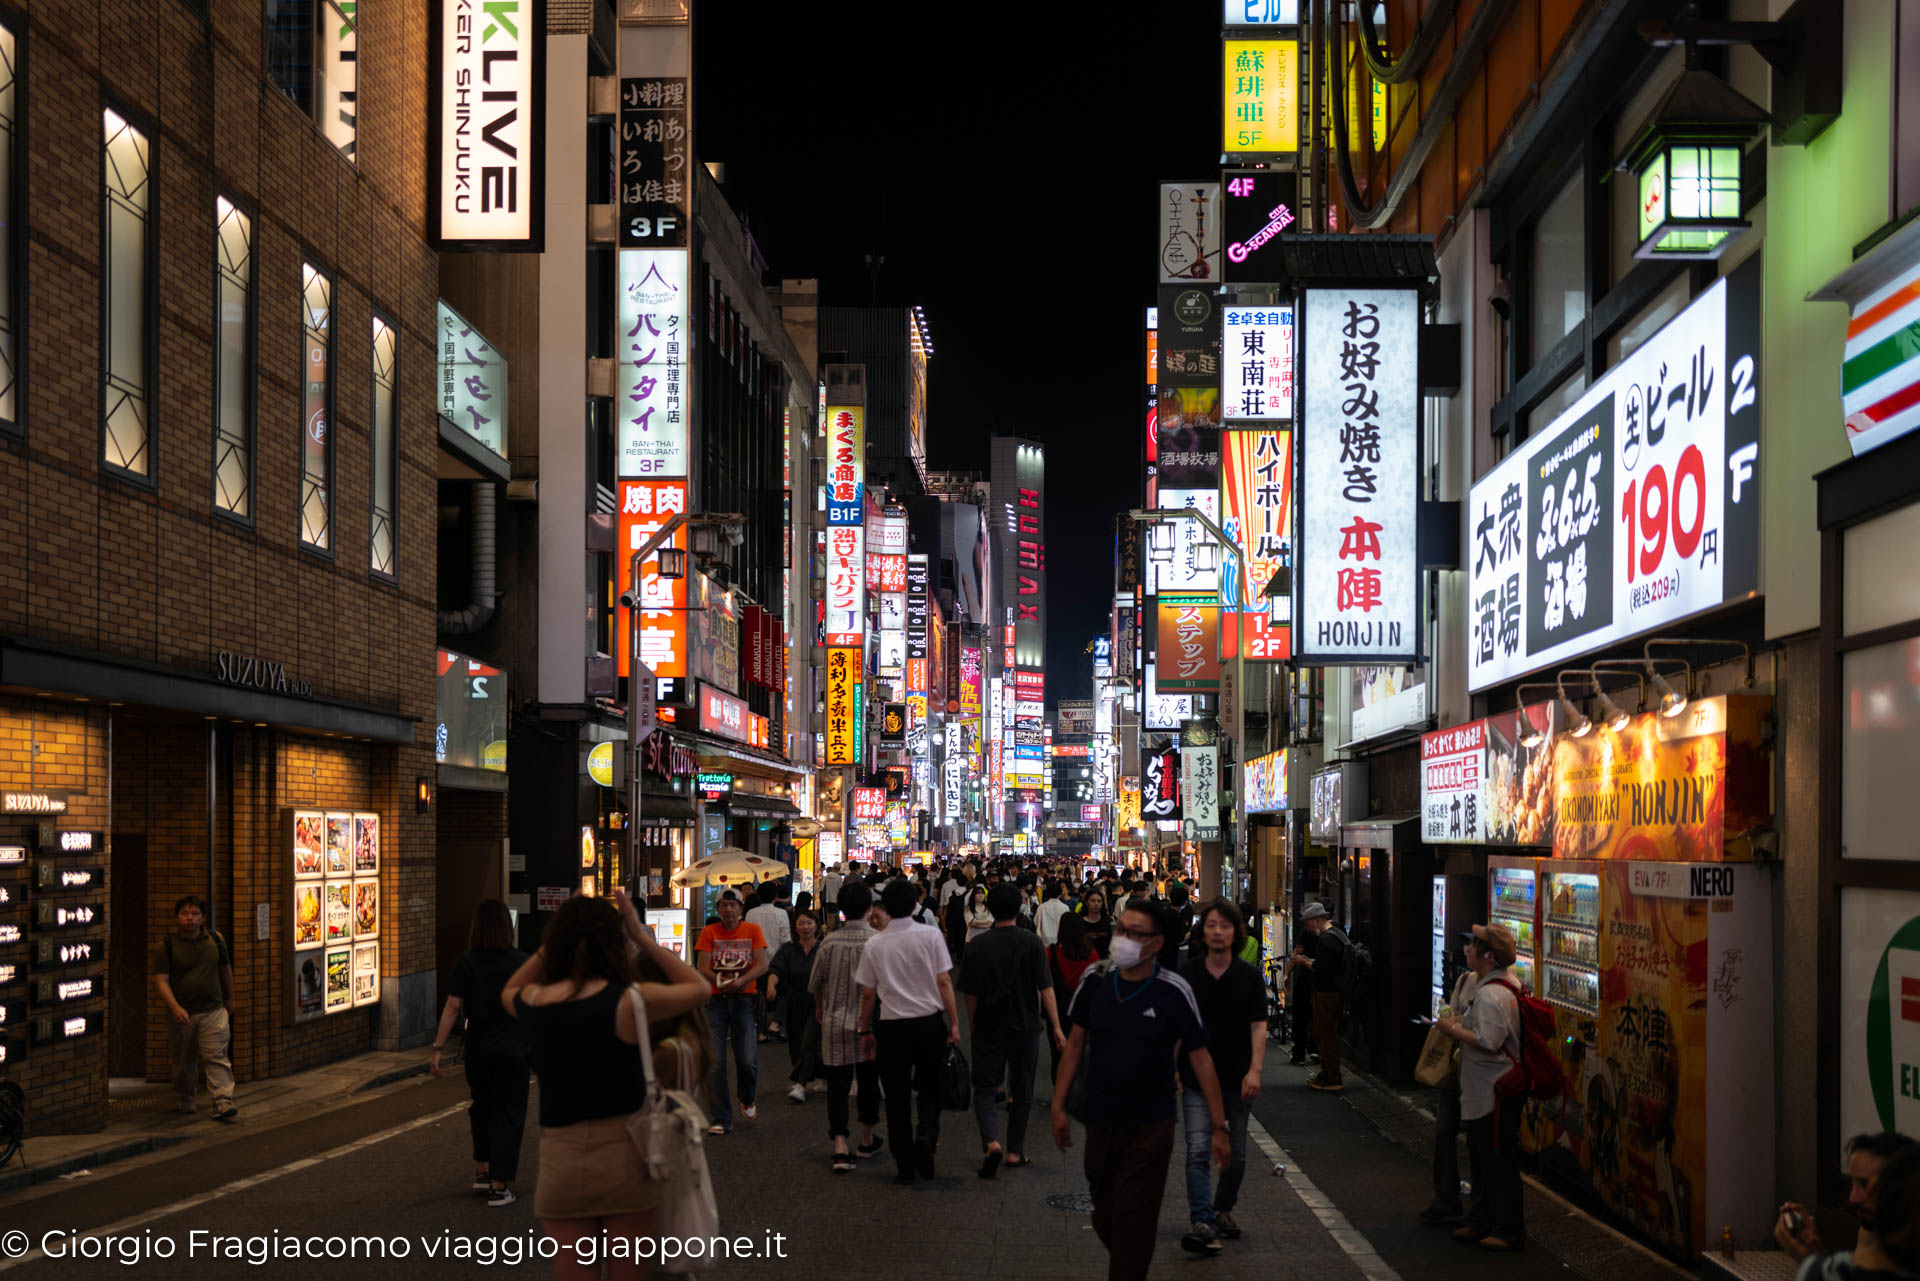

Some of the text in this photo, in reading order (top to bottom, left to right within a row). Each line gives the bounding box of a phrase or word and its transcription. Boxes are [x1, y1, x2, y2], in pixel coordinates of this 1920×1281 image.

[624, 83, 685, 107] 小料理
[455, 69, 471, 213] SHINJUKU
[1238, 130, 1262, 145] 5F
[1227, 178, 1256, 197] 4F
[631, 217, 677, 237] 3F
[1268, 203, 1288, 220] CLUB
[1227, 311, 1293, 326] 全卓全自動
[627, 313, 661, 432] バンタイ
[667, 314, 680, 424] タイ国料理専門店
[1241, 329, 1266, 417] 東南荘
[1269, 356, 1280, 408] 専門店
[1226, 405, 1239, 417] 3F
[1339, 300, 1382, 503] お好み焼き
[632, 440, 674, 449] BAN-THAI
[1728, 353, 1759, 505] 2F
[626, 448, 680, 457] RESTAURANT
[639, 459, 665, 473] 3F
[835, 411, 857, 502] まぐろ商店
[1161, 451, 1219, 466] 酒場牧場
[623, 486, 684, 514] 焼肉
[1256, 436, 1281, 558] ハイボール
[829, 507, 861, 521] B1F
[1475, 482, 1522, 580] 大衆
[1337, 516, 1384, 613] 本陣
[1318, 622, 1402, 647] HONJIN
[1474, 572, 1522, 668] 酒場
[835, 634, 855, 645] 4F
[1176, 606, 1206, 676] ステップ
[1251, 639, 1282, 656] 2F
[753, 632, 761, 680] ANRAKUTEI
[764, 639, 772, 687] ANRAKUTEI
[775, 645, 783, 692] ANRAKUTEI
[217, 650, 287, 694] SUZUYA
[698, 774, 731, 783] Trattoria
[5, 793, 49, 812] SUZUYA
[1450, 792, 1477, 839] 本陣
[1561, 792, 1620, 824] OKONOMIYAKI
[1201, 831, 1219, 844] B1F
[1690, 867, 1734, 898] NERO
[1616, 998, 1669, 1053] 本陣
